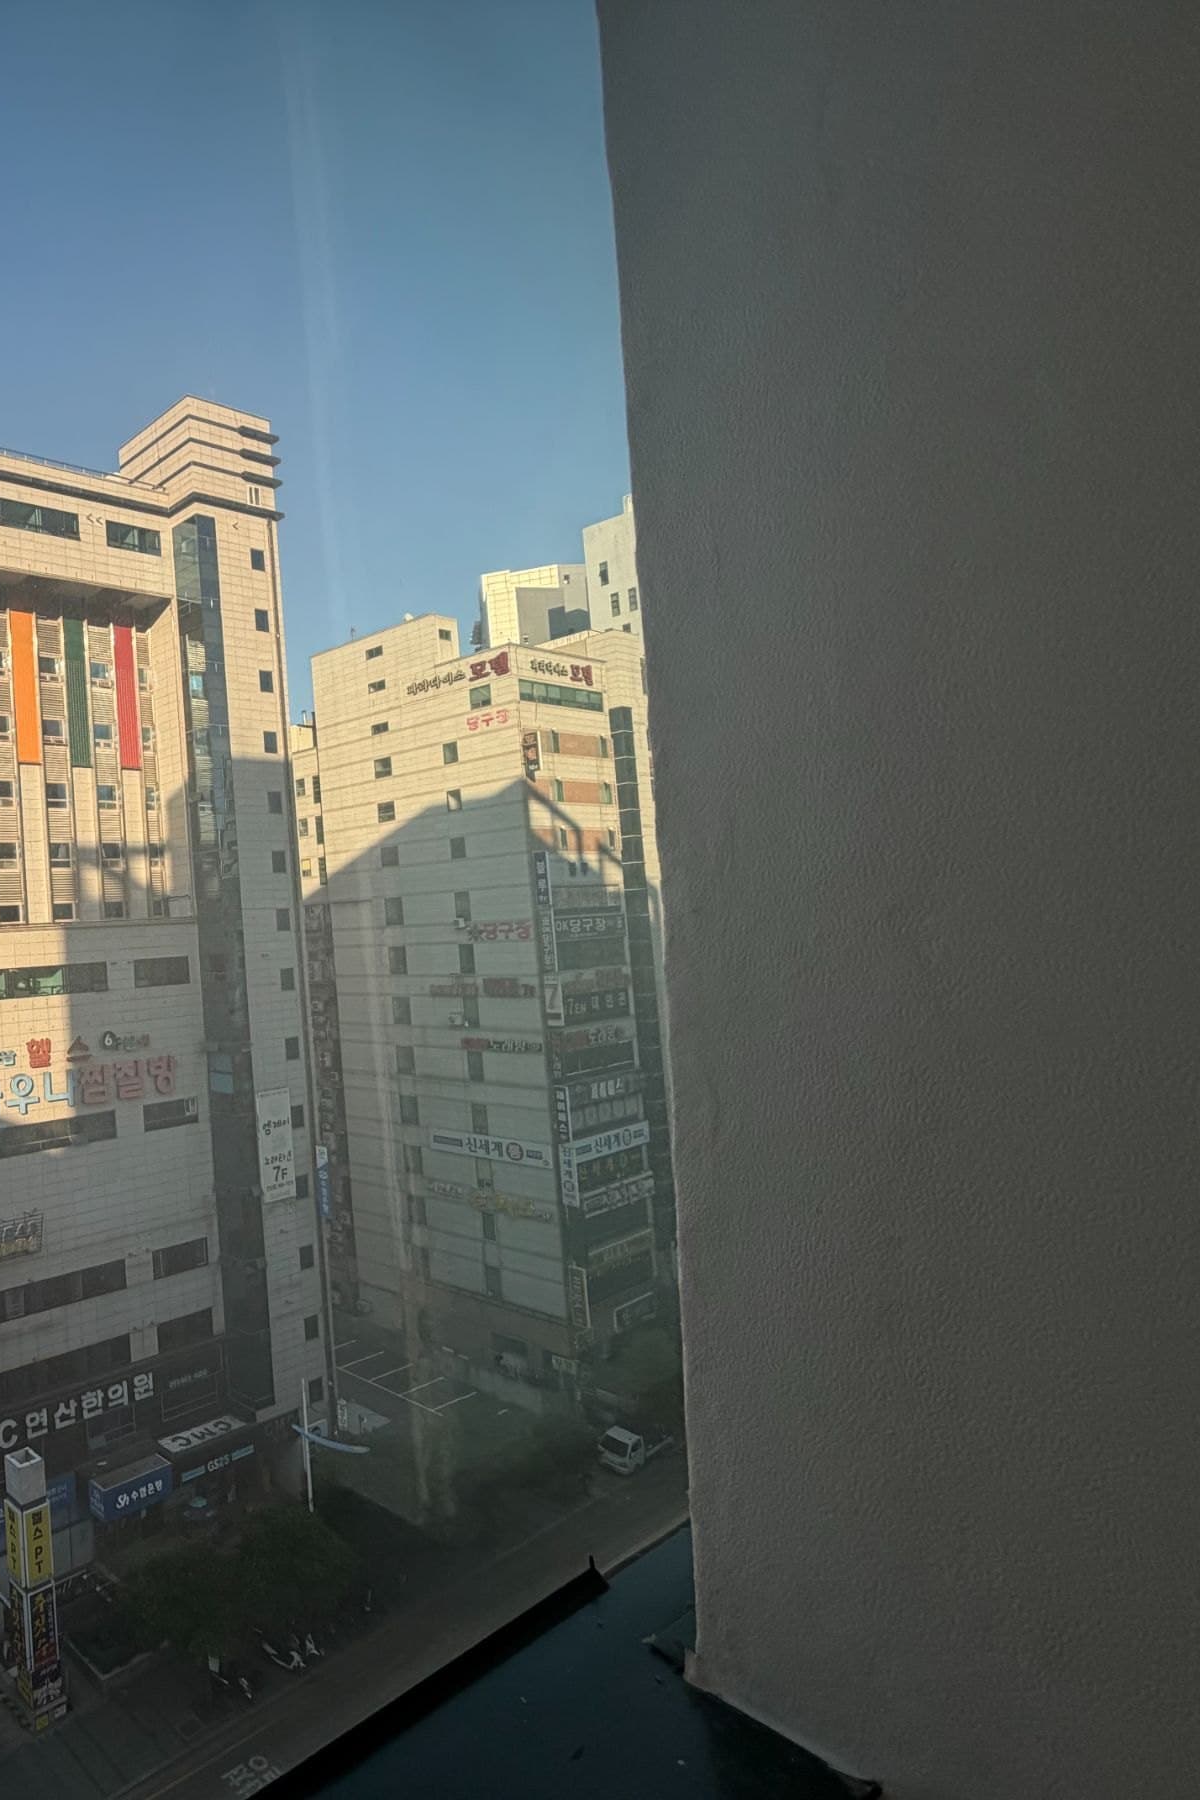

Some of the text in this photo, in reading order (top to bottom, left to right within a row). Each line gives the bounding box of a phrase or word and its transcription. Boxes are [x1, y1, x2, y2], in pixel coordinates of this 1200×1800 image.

[468, 651, 511, 682] 모텔
[570, 663, 594, 687] 모텔
[78, 1055, 177, 1105] 찜질방
[465, 1137, 504, 1158] 신세계
[273, 1165, 288, 1182] 7F
[207, 1453, 231, 1472] GS25
[115, 1493, 129, 1510] Sh
[130, 1480, 163, 1502] 수협은행
[33, 1545, 44, 1574] PT
